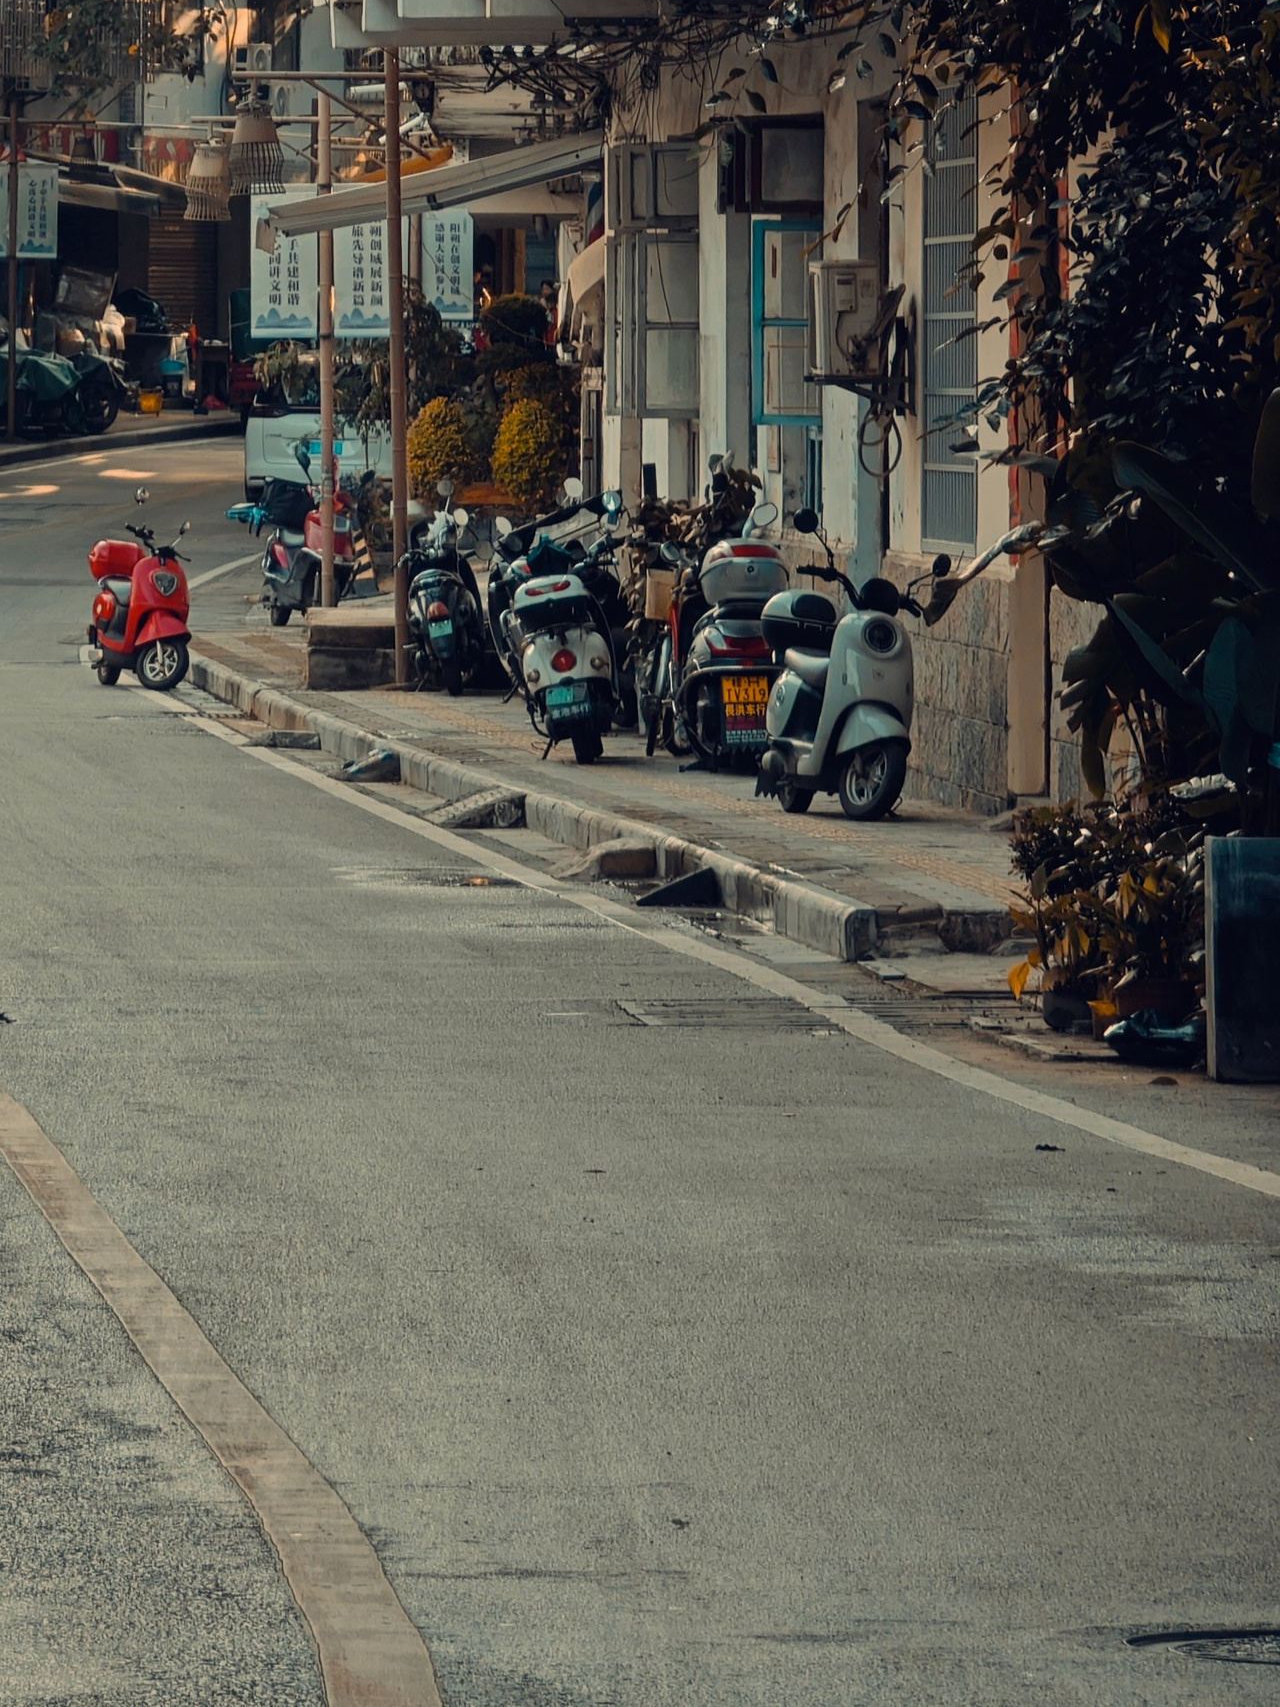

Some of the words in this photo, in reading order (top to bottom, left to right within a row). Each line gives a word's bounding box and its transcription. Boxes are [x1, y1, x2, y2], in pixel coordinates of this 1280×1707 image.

[369, 220, 383, 306] 朔创城展新颜
[727, 688, 766, 703] TV319
